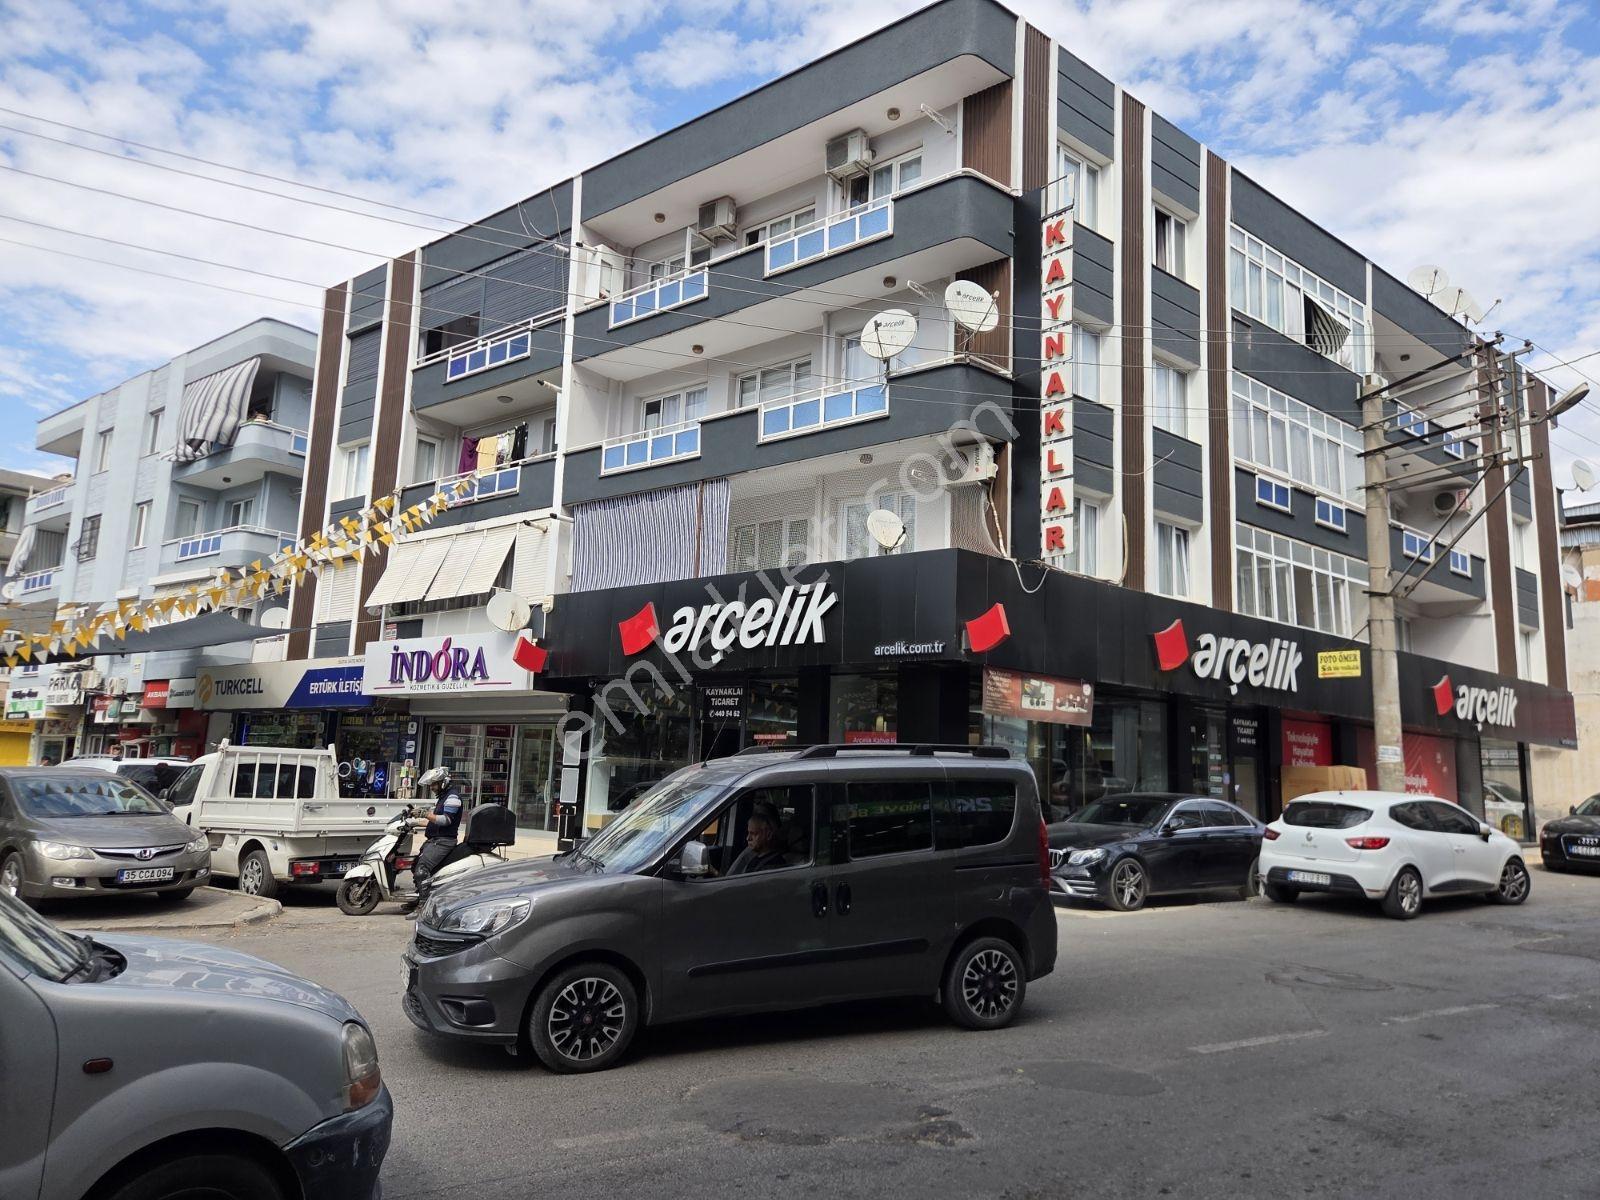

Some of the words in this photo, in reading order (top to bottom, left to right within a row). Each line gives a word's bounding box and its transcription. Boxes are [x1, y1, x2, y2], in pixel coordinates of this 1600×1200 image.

[1045, 218, 1066, 551] KAYNAKLAR
[663, 582, 839, 664] arçelik
[874, 641, 945, 656] arcelik.com.tr
[1192, 633, 1303, 695] arçelik
[215, 678, 264, 696] TURKCELL
[309, 679, 337, 694] ERTÜRK
[338, 677, 363, 695] İLETİŞİ
[711, 697, 739, 706] TİCARET
[1456, 684, 1518, 732] arçelik
[125, 871, 136, 880] 35
[156, 868, 172, 878] 094
